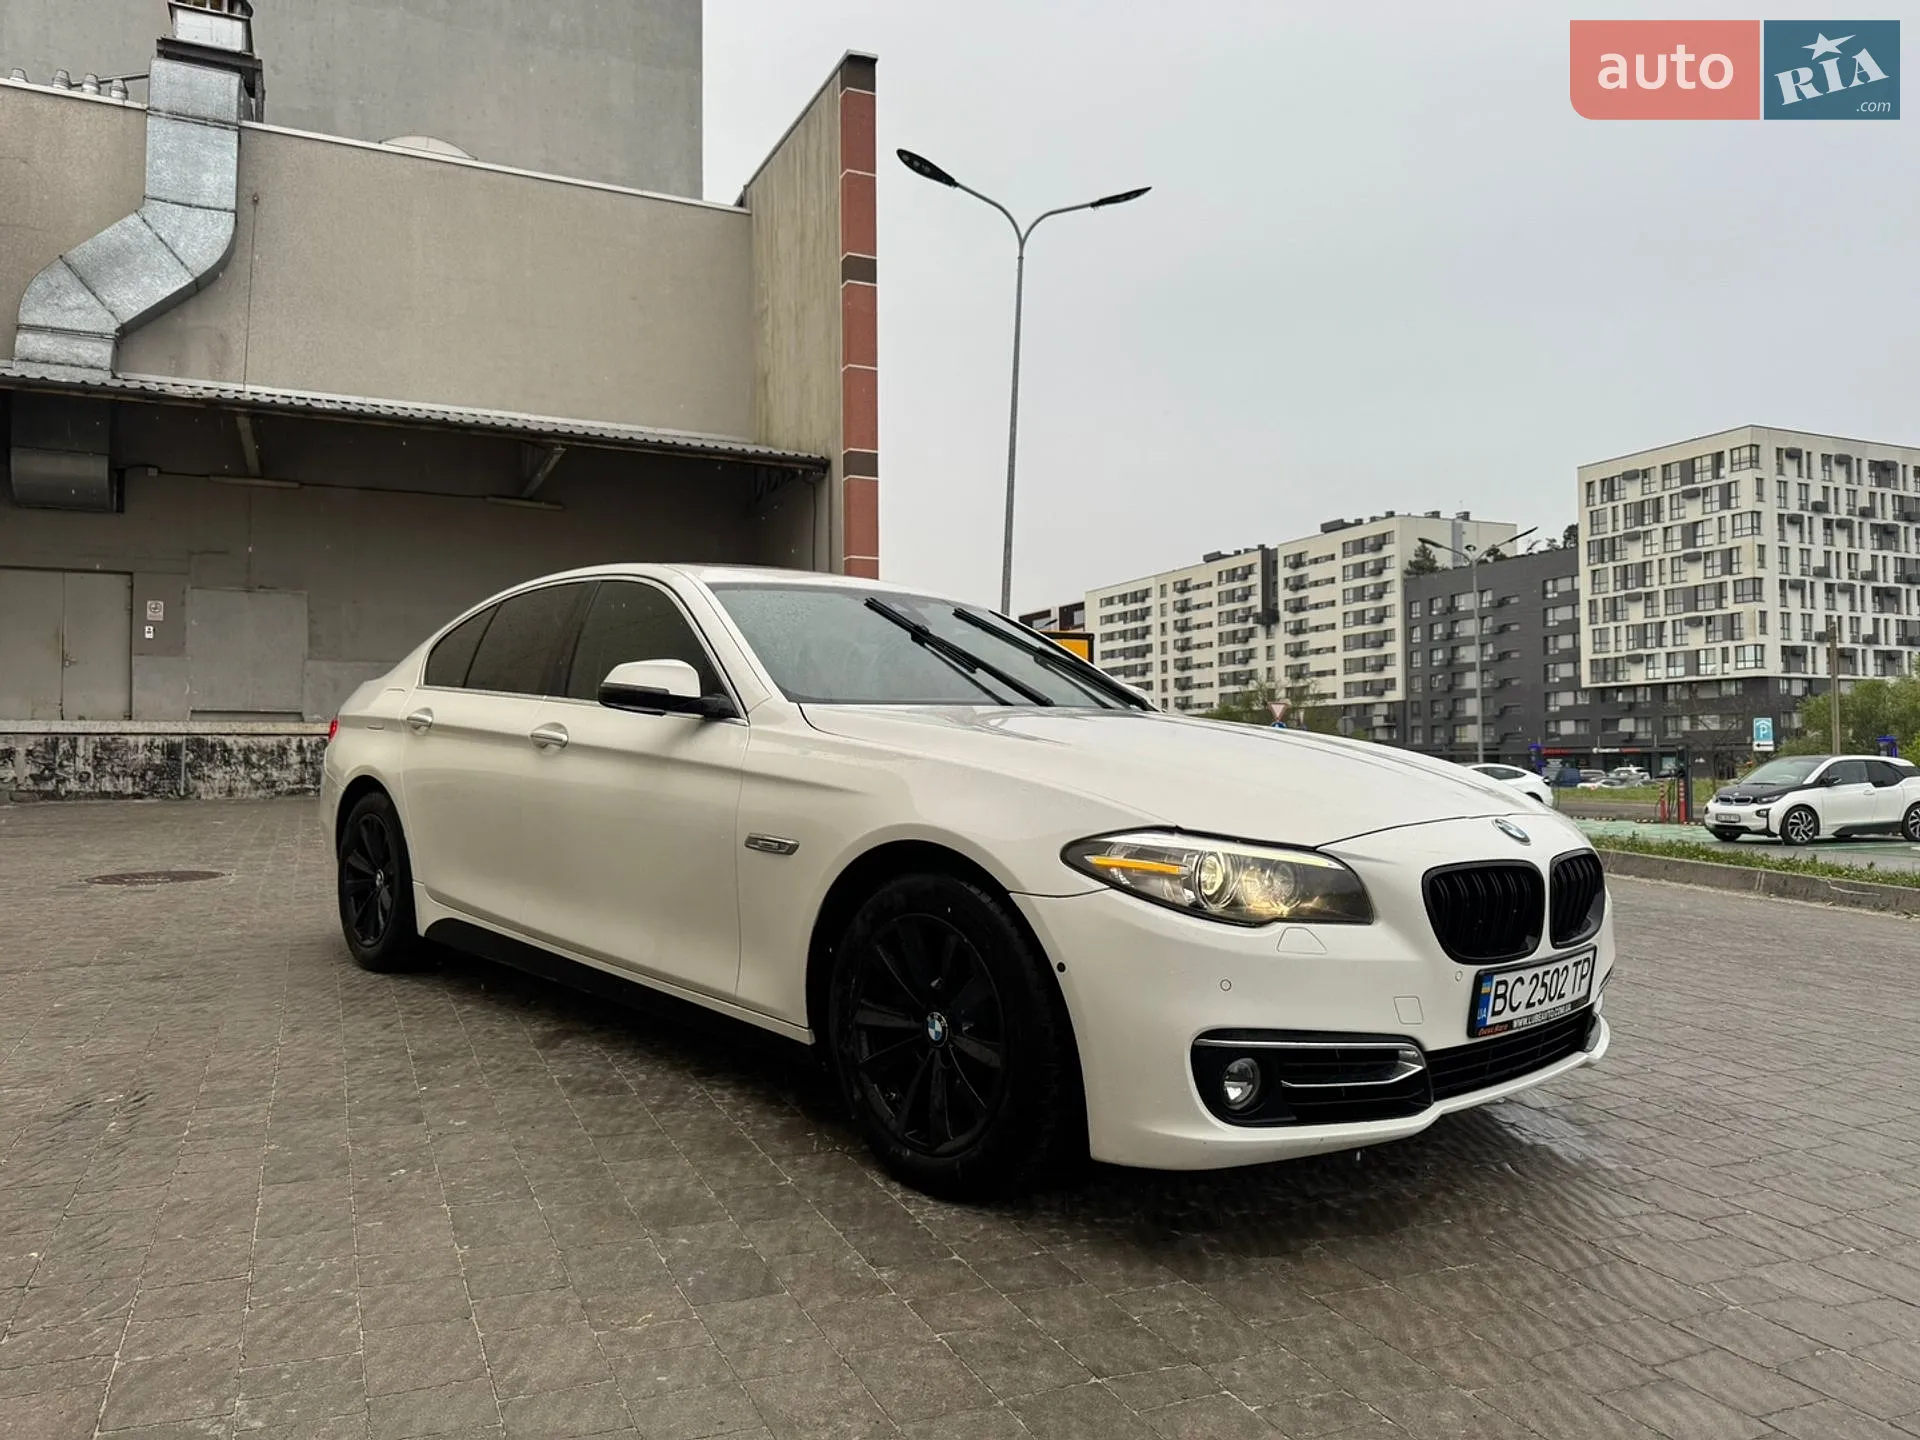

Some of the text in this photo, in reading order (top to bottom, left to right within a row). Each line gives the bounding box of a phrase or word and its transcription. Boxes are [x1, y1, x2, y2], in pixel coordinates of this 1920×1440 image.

[1490, 957, 1591, 1017] BC 2502 TP
[1477, 1007, 1487, 1020] UA
